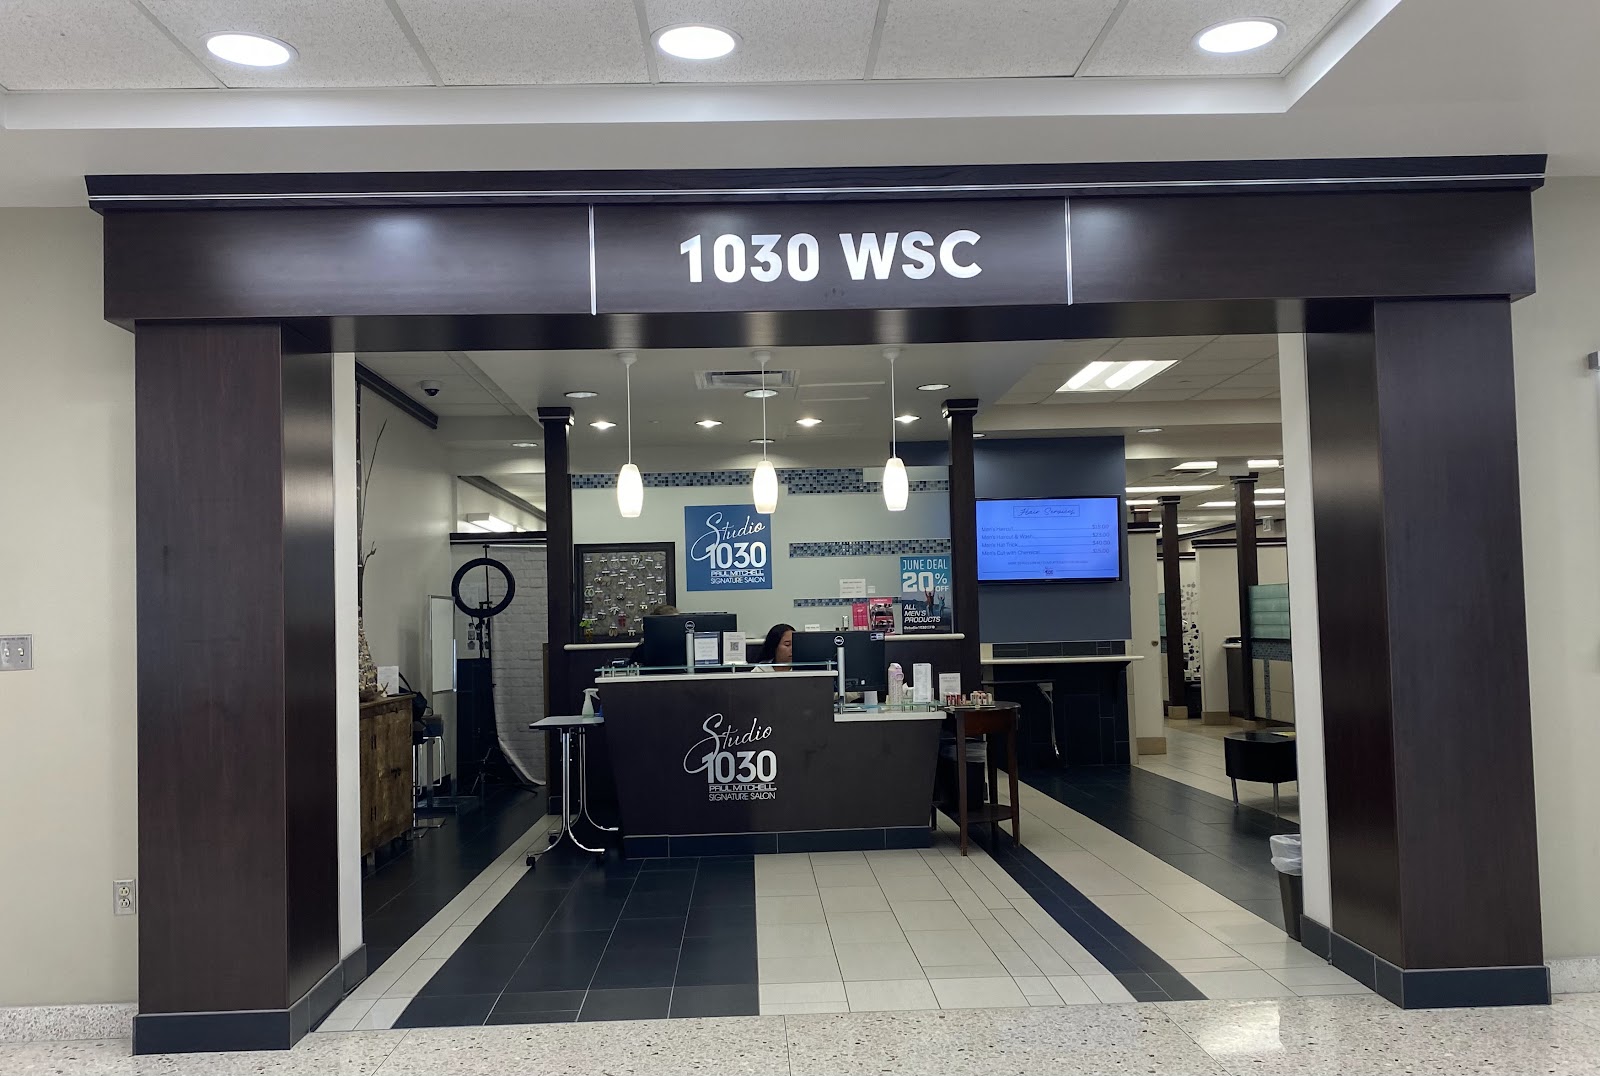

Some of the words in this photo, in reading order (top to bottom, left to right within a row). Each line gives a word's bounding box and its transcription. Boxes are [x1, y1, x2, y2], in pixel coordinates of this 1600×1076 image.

[680, 233, 820, 283] 1030
[839, 229, 983, 281] WSC
[1017, 508, 1040, 516] Hair
[1043, 507, 1076, 516] Services
[691, 512, 766, 561] Studio
[705, 542, 767, 569] 1030
[903, 559, 925, 571] JUNE
[926, 558, 948, 570] DEAL
[711, 569, 730, 577] PAUL
[730, 569, 765, 577] MITCHELL
[711, 577, 743, 585] SIGNATURE
[744, 576, 766, 584] SALON
[902, 572, 948, 592] 20%
[935, 585, 949, 593] OFF
[904, 616, 941, 624] PRODUCTS
[683, 713, 773, 774] Studio
[702, 750, 777, 784] 1030
[709, 784, 732, 792] PAUL
[732, 783, 775, 791] MITCHELL
[709, 793, 749, 801] SIGNATURE
[750, 792, 776, 800] SALON
